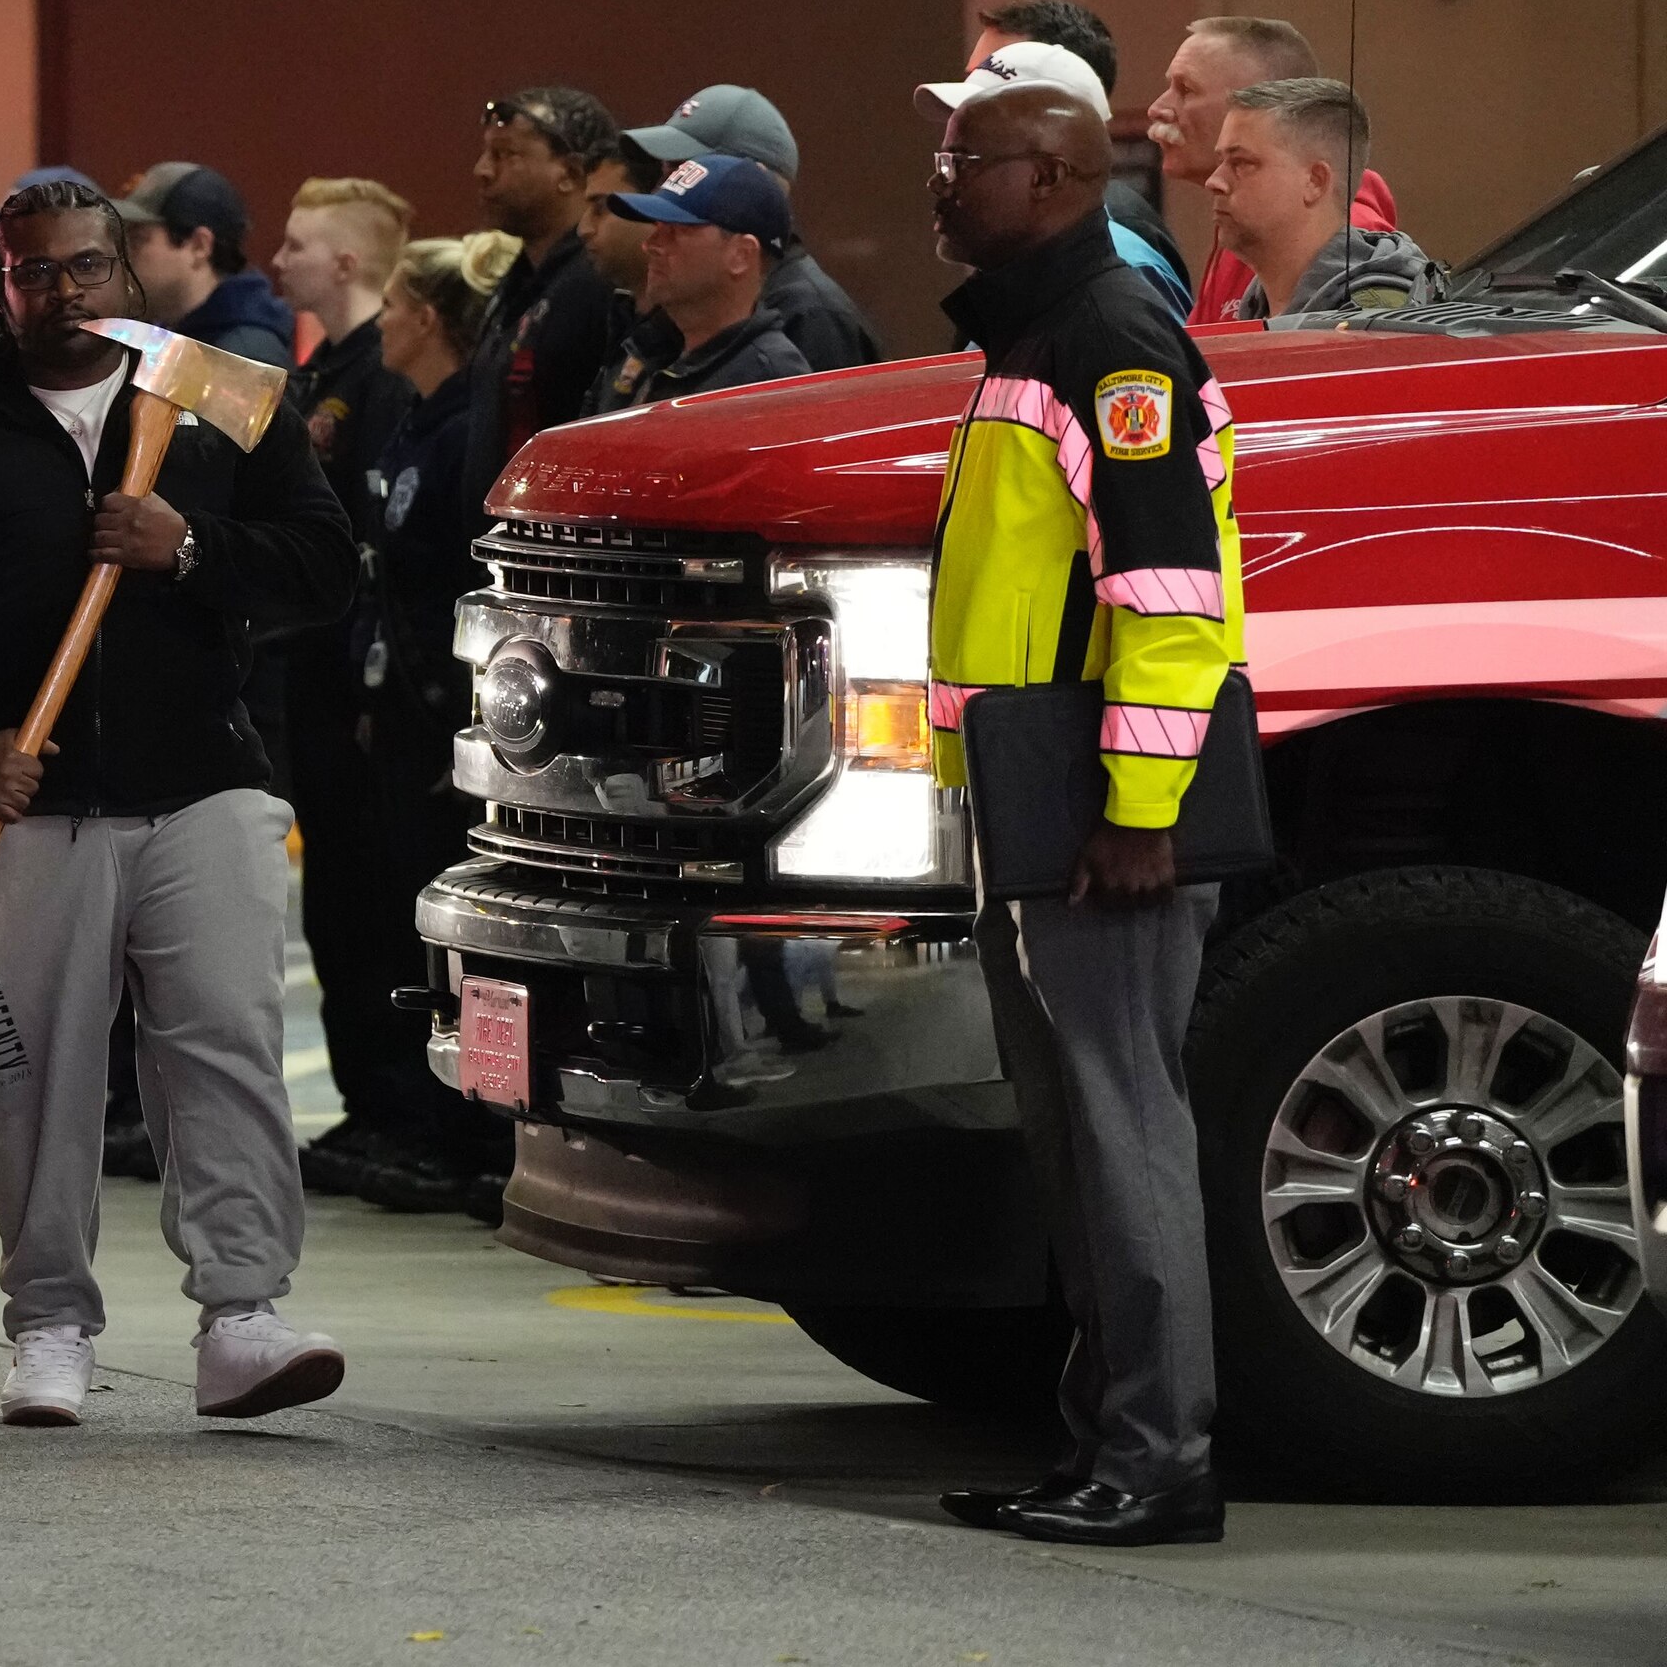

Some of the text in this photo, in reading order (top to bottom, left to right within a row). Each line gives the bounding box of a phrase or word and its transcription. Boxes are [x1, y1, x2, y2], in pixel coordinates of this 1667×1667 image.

[1098, 374, 1165, 391] BALTIMORE CITY
[1110, 443, 1164, 456] FIRE SERVICE
